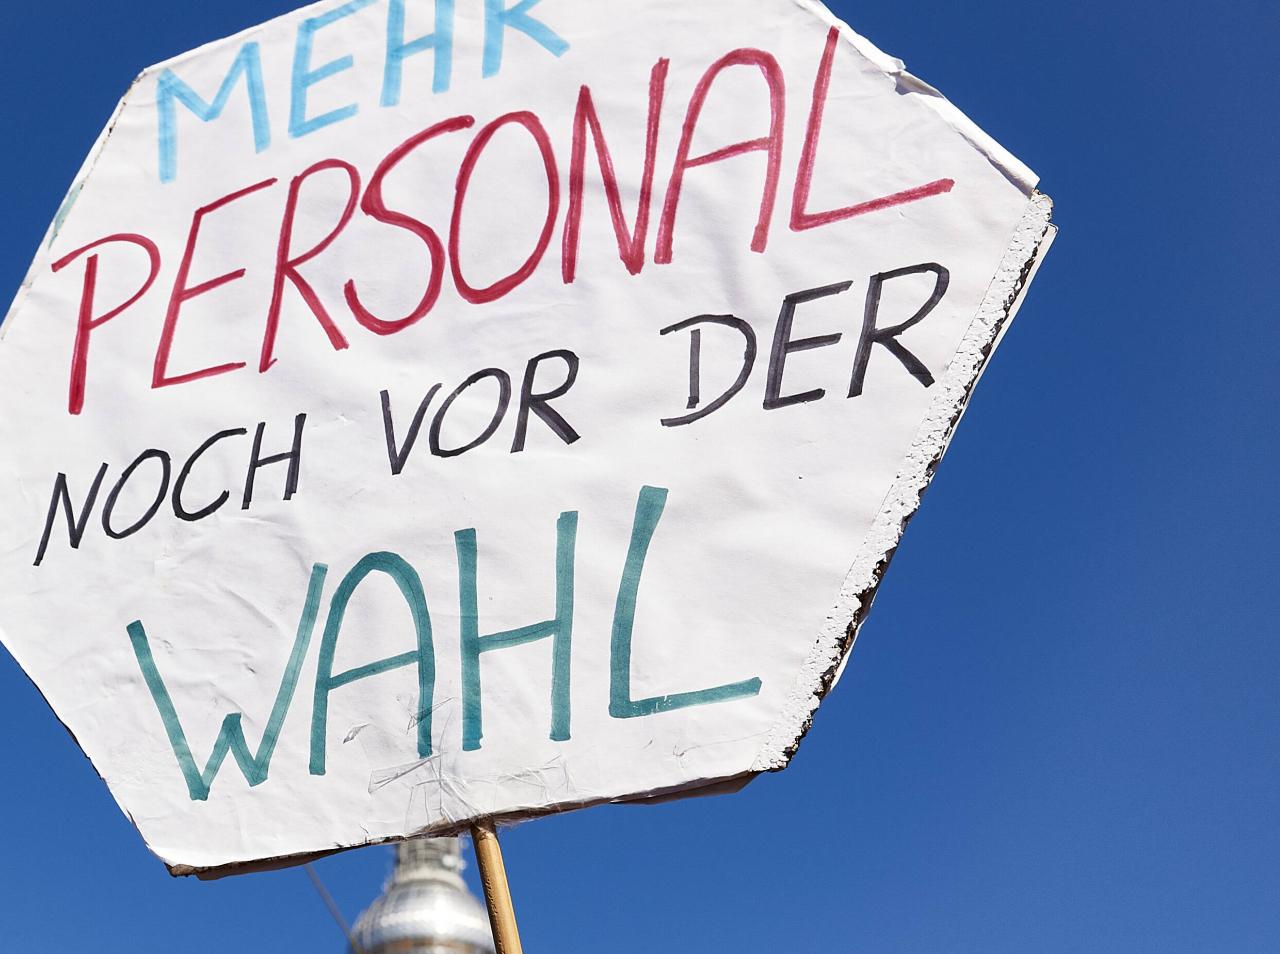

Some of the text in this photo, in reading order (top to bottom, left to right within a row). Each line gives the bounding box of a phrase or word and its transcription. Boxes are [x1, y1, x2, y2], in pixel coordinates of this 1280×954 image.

[51, 26, 955, 415] PERSONAL
[32, 262, 950, 567] NOCH VOR DER
[126, 486, 761, 801] WAHL
